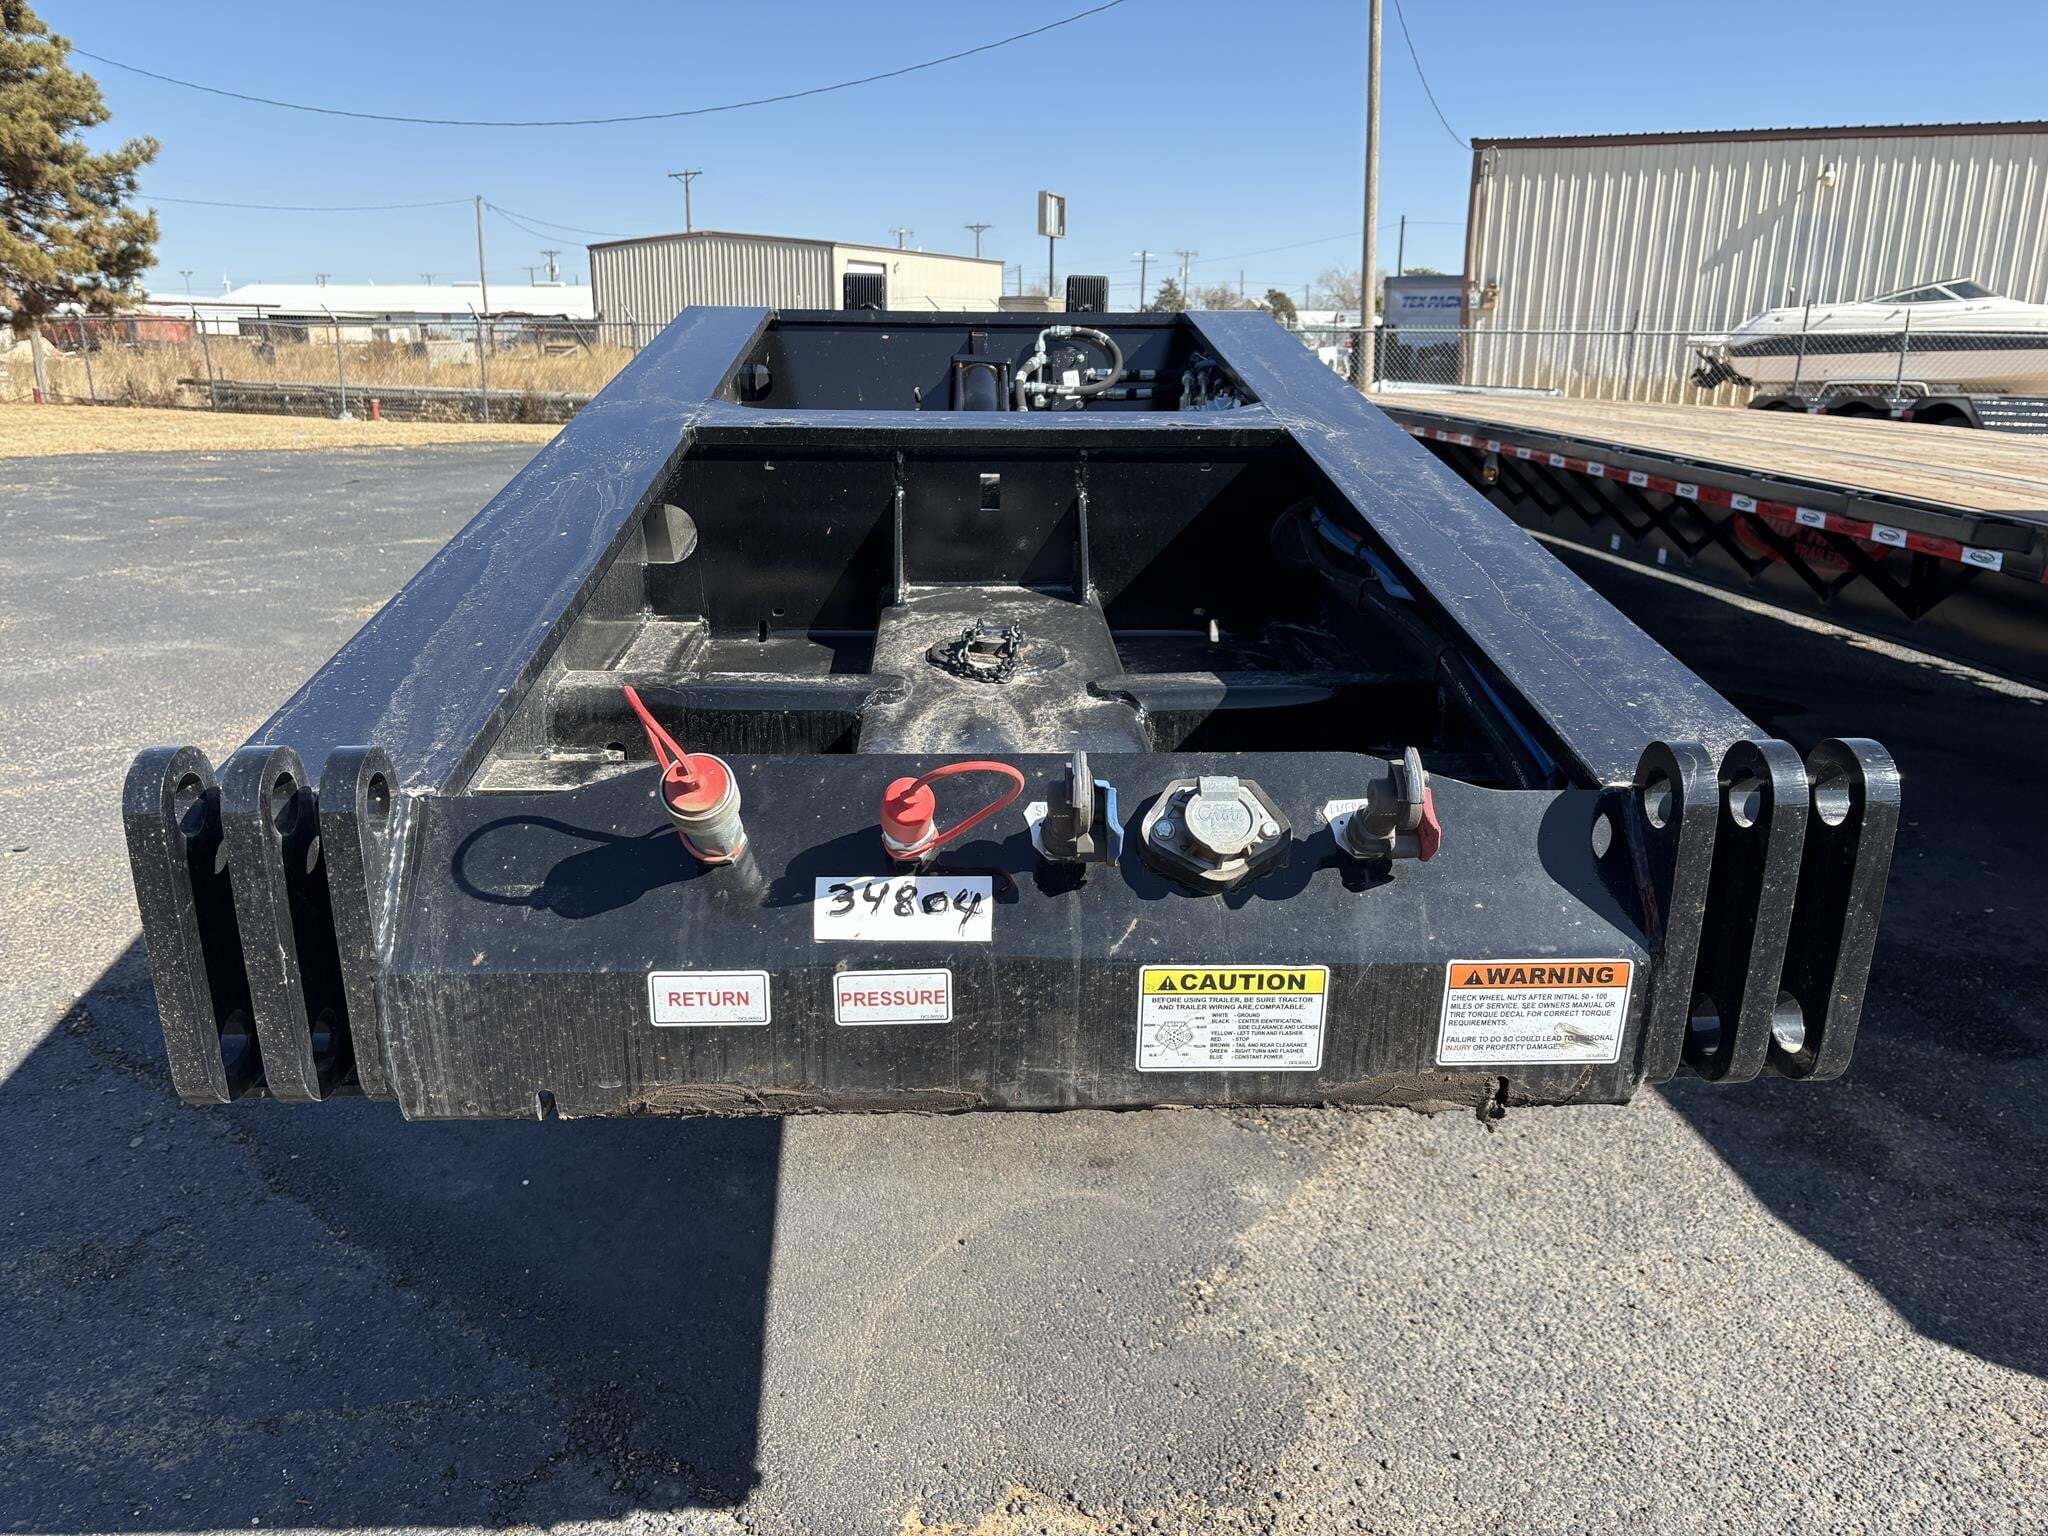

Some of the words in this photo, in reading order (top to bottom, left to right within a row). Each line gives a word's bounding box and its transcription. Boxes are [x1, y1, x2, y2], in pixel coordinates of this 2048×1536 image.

[827, 881, 984, 936] 34804
[1180, 974, 1306, 990] CAUTION
[1487, 966, 1614, 984] WARNING
[668, 991, 750, 1006] RETURN
[840, 990, 946, 1007] PRESSURE
